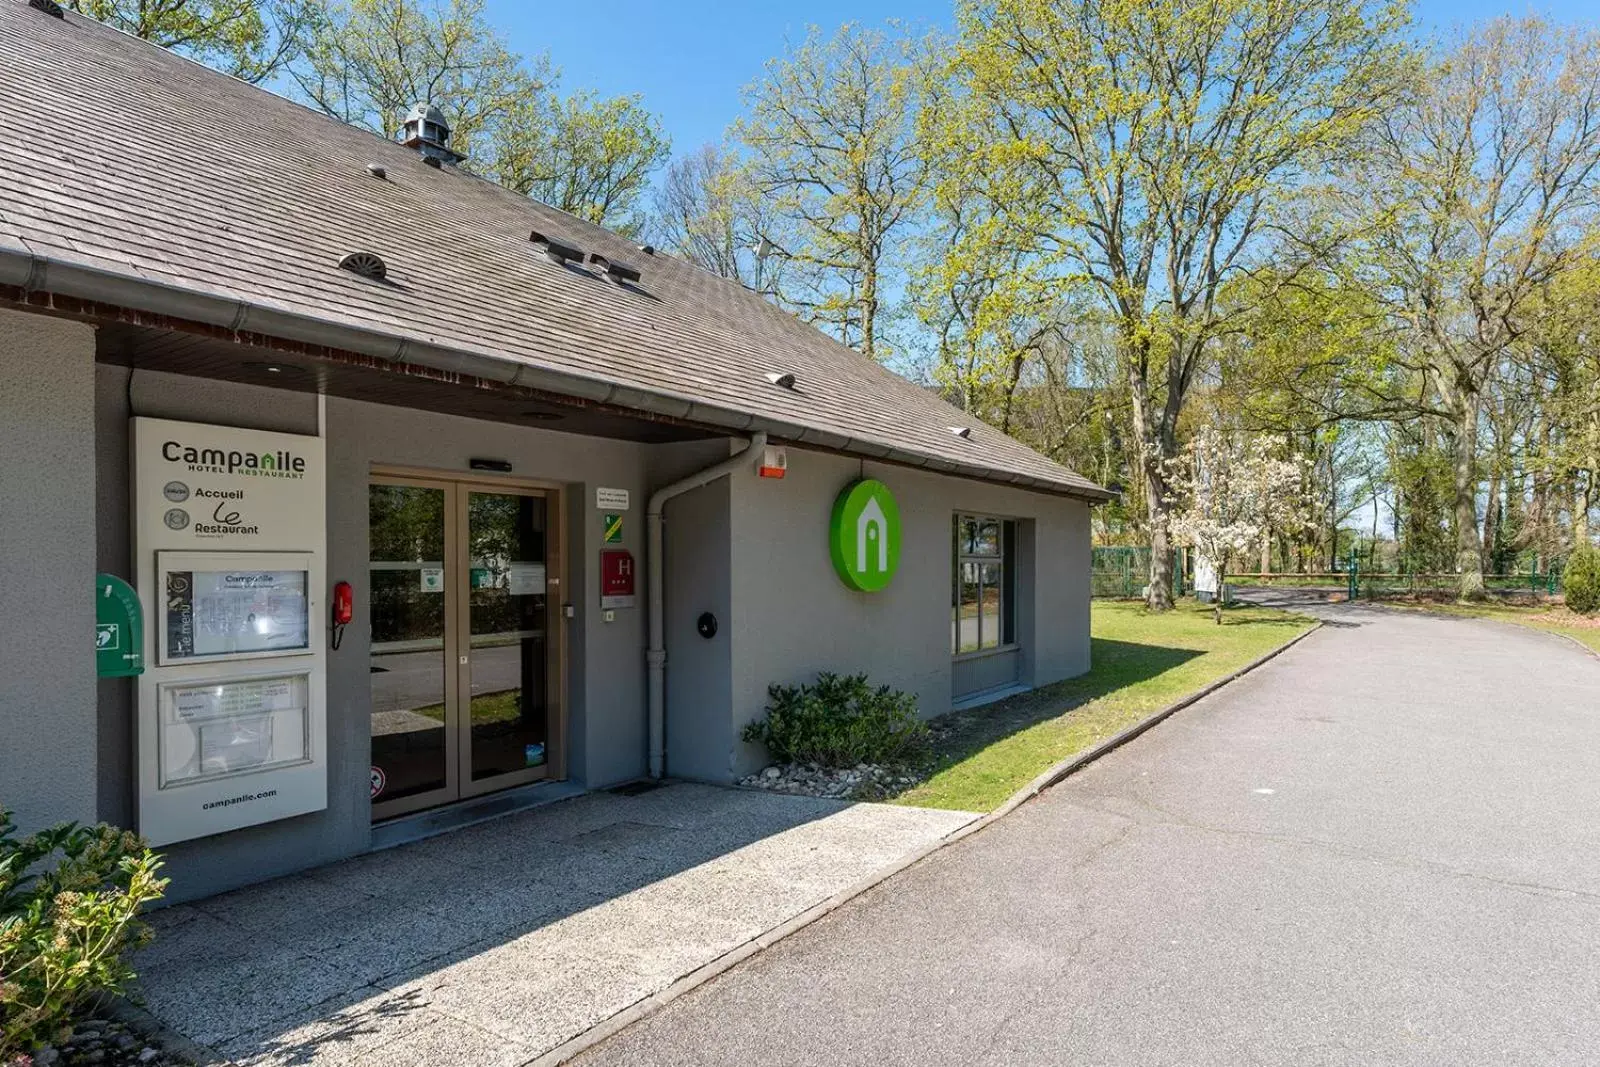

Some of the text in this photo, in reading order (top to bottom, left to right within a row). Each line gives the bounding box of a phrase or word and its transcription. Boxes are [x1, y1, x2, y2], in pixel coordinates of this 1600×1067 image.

[162, 441, 305, 474] Campanile
[188, 464, 305, 480] HOTEL RESTAURANT
[195, 488, 243, 500] Accueil
[195, 523, 259, 535] Restaurant
[619, 559, 631, 575] H
[202, 789, 277, 810] campanile.com
